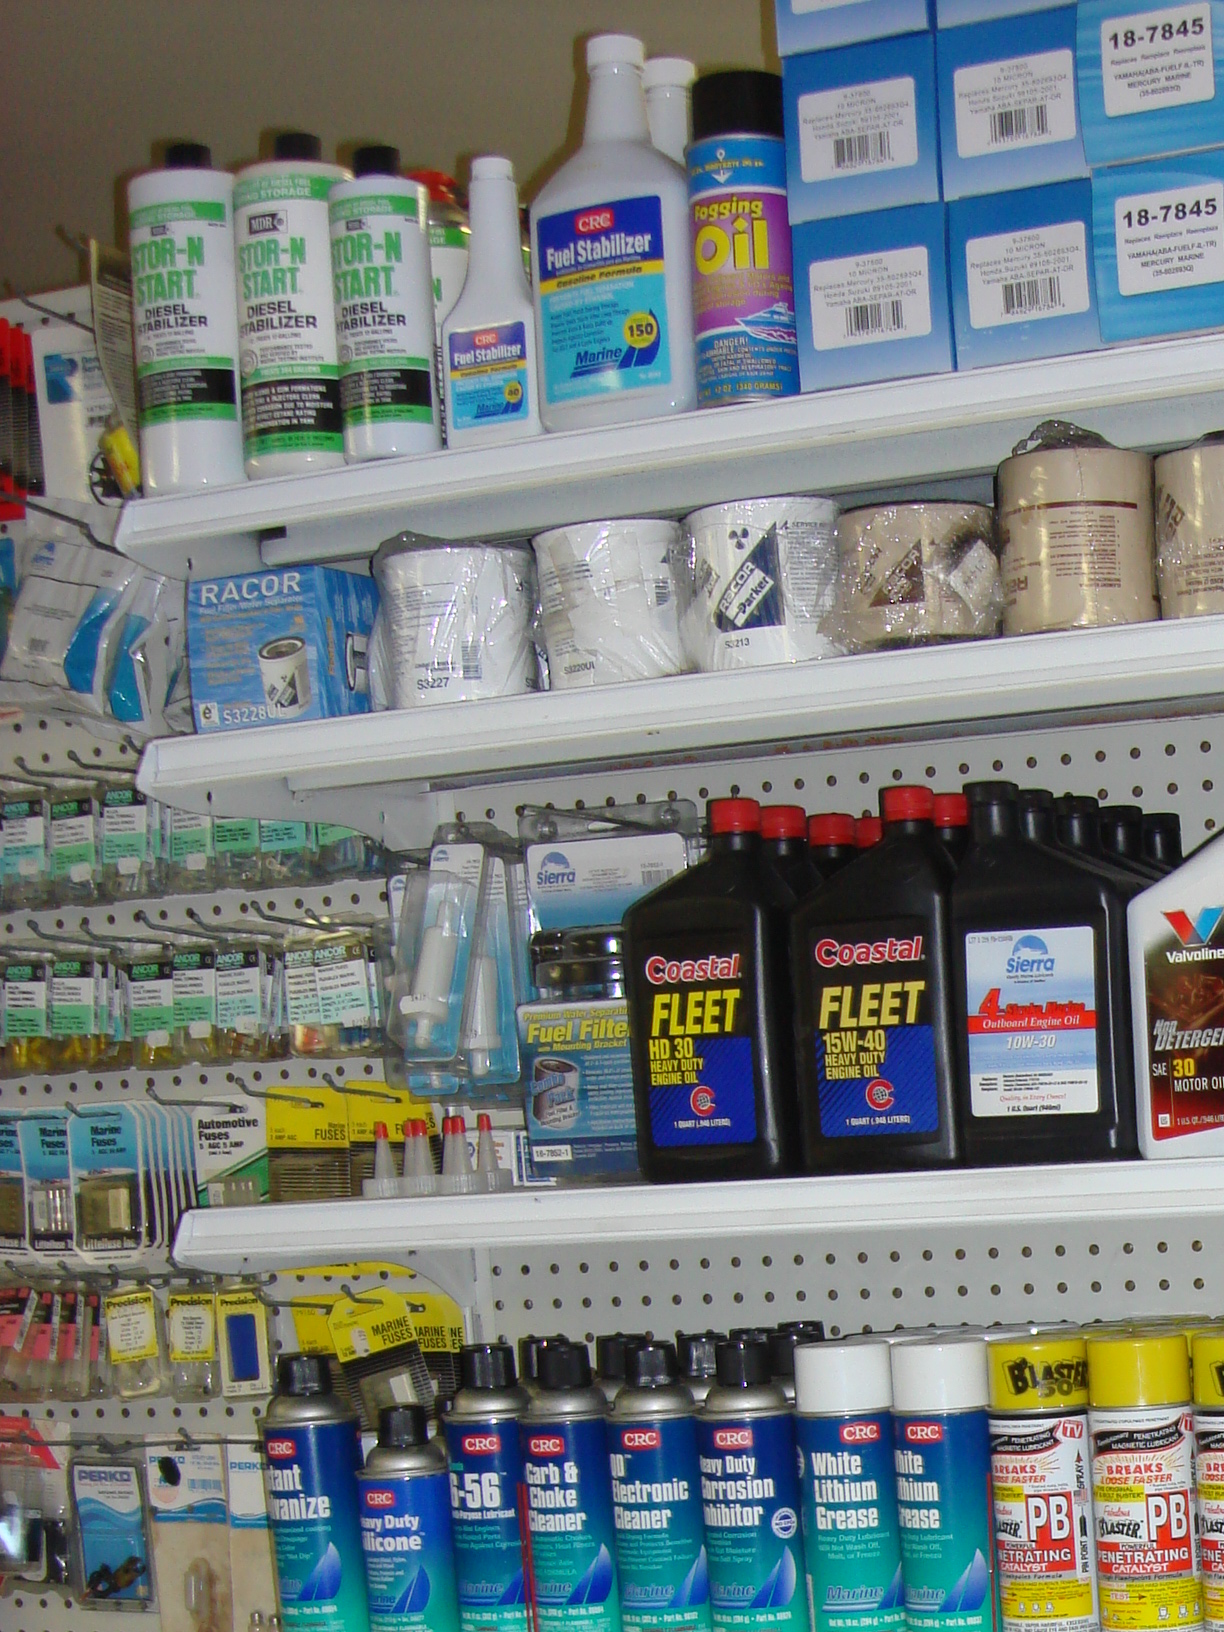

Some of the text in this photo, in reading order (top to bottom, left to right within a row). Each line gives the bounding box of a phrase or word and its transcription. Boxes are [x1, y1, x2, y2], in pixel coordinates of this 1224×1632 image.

[1109, 18, 1204, 50] 18-7845
[250, 214, 273, 232] MDR
[578, 213, 611, 231] CRC
[1122, 199, 1218, 229] 18-7845
[547, 233, 651, 271] Fuel Stabilizer
[695, 216, 769, 275] Oil
[146, 304, 189, 318] DIESEL
[627, 323, 653, 338] 150
[575, 347, 622, 365] Marine
[200, 572, 300, 606] RACOR
[739, 575, 771, 615] Parker
[223, 704, 285, 726] S3228UL
[314, 945, 346, 960] ANCOR
[815, 936, 923, 968] Coastal
[1166, 947, 1224, 964] Valvoline
[132, 963, 159, 975] ANCOR
[646, 953, 740, 985] Coastal
[1006, 955, 1055, 974] Sierra
[651, 989, 740, 1036] FLEET
[819, 981, 925, 1029] FLEET
[982, 1015, 1079, 1030] Outboard Engine Oil
[649, 1038, 693, 1060] HD 30
[822, 1030, 886, 1053] 15W-40
[1006, 1034, 1056, 1049] 10W-30
[650, 1057, 703, 1073] HEAVY DUTY
[825, 1052, 886, 1067] HEAVY DUTY
[1152, 1058, 1195, 1077] SAE 30
[651, 1071, 698, 1086] ENGINE OIL
[826, 1065, 880, 1080] ENGINE OIL
[1174, 1077, 1209, 1092] MOTOR
[90, 1124, 122, 1136] Marine
[198, 1118, 259, 1130] Automotive
[91, 1136, 117, 1147] Fuses
[198, 1130, 229, 1141] Fuses
[314, 1129, 346, 1141] FUSES
[382, 1328, 413, 1344] FUSES
[1064, 1424, 1083, 1438] TV
[726, 1455, 755, 1474] Duty
[812, 1452, 862, 1475] White
[1107, 1462, 1163, 1475] BREAKS
[78, 1470, 132, 1482] PERKO
[526, 1461, 578, 1485] Carb &
[1101, 1473, 1172, 1485] LOOSE FASTER
[367, 1493, 392, 1504] CRC
[530, 1487, 577, 1508] Choke
[612, 1478, 689, 1503] Electronic
[814, 1480, 878, 1502] Lithium
[528, 1512, 586, 1532] Cleaner
[817, 1508, 878, 1529] Grease
[1030, 1497, 1070, 1542] PB
[1149, 1493, 1187, 1541] PB
[1112, 1562, 1168, 1573] CATALYST
